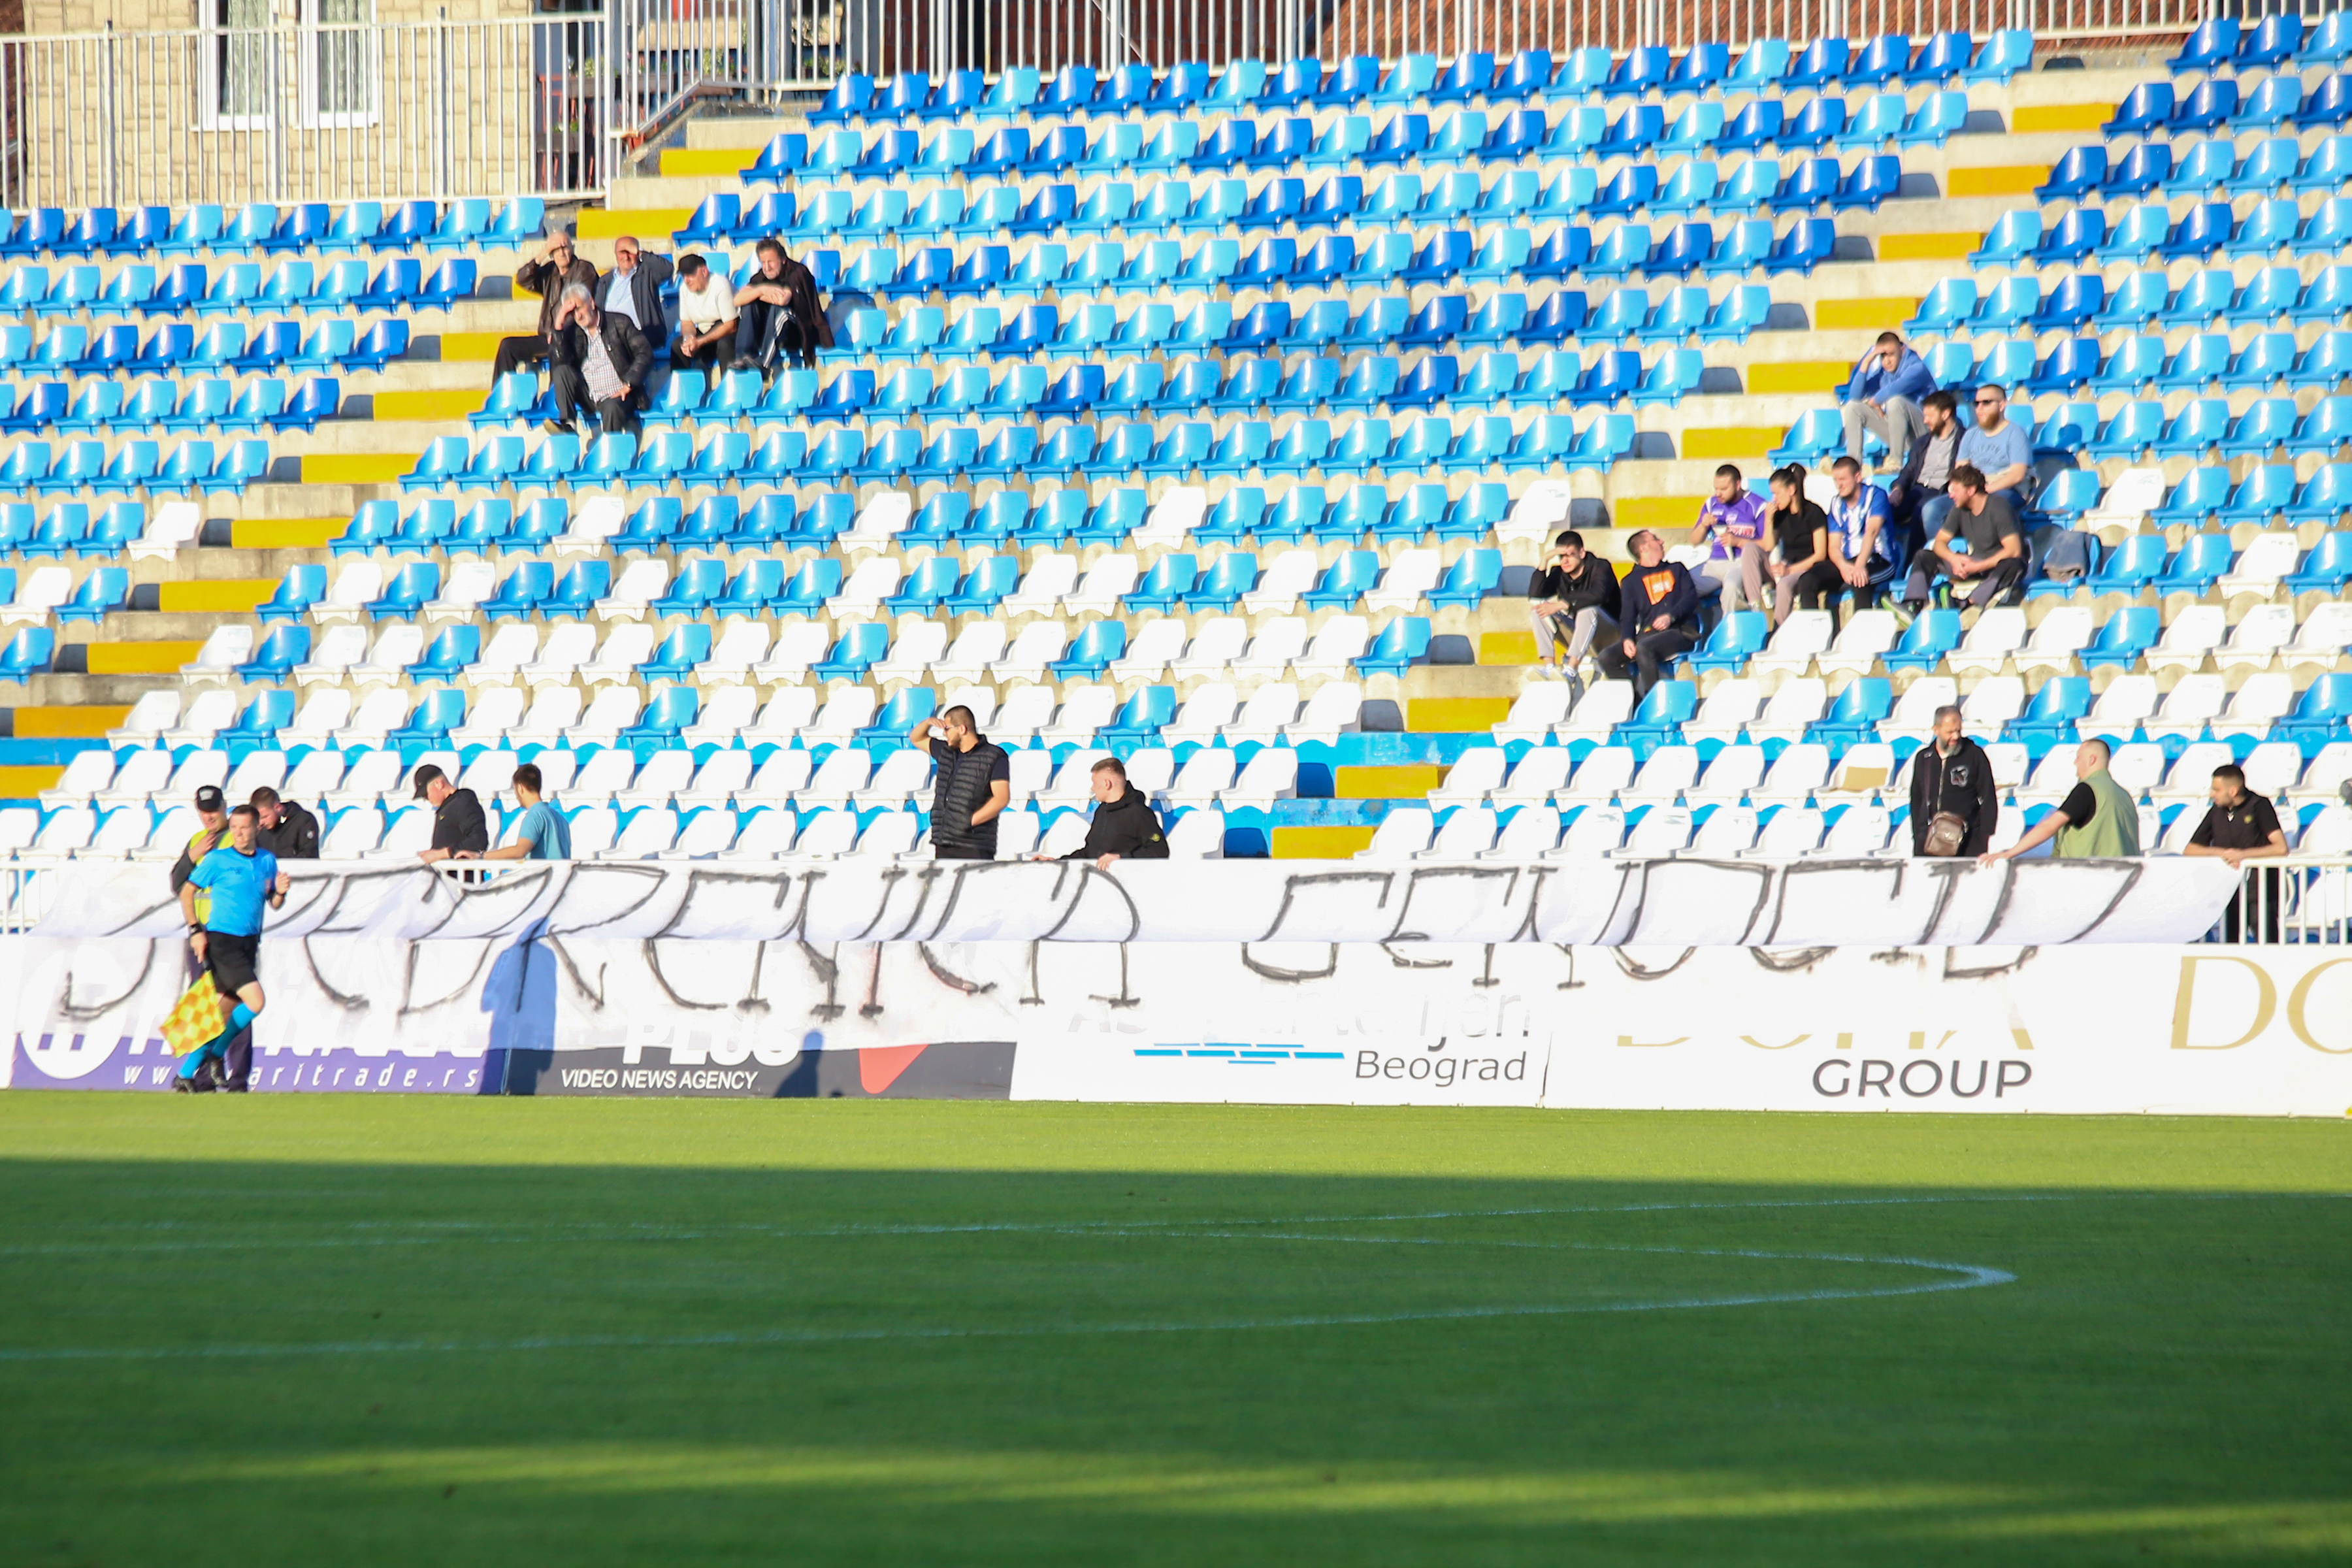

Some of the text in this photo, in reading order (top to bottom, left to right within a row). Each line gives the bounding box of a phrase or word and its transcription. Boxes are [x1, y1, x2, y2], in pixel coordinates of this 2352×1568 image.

[124, 1062, 480, 1088] wwaritrade.rs
[561, 1068, 759, 1090] VIDEO NEWS AGENCY
[1355, 1050, 1526, 1087] Beograd
[1812, 1059, 2032, 1098] GROUP
